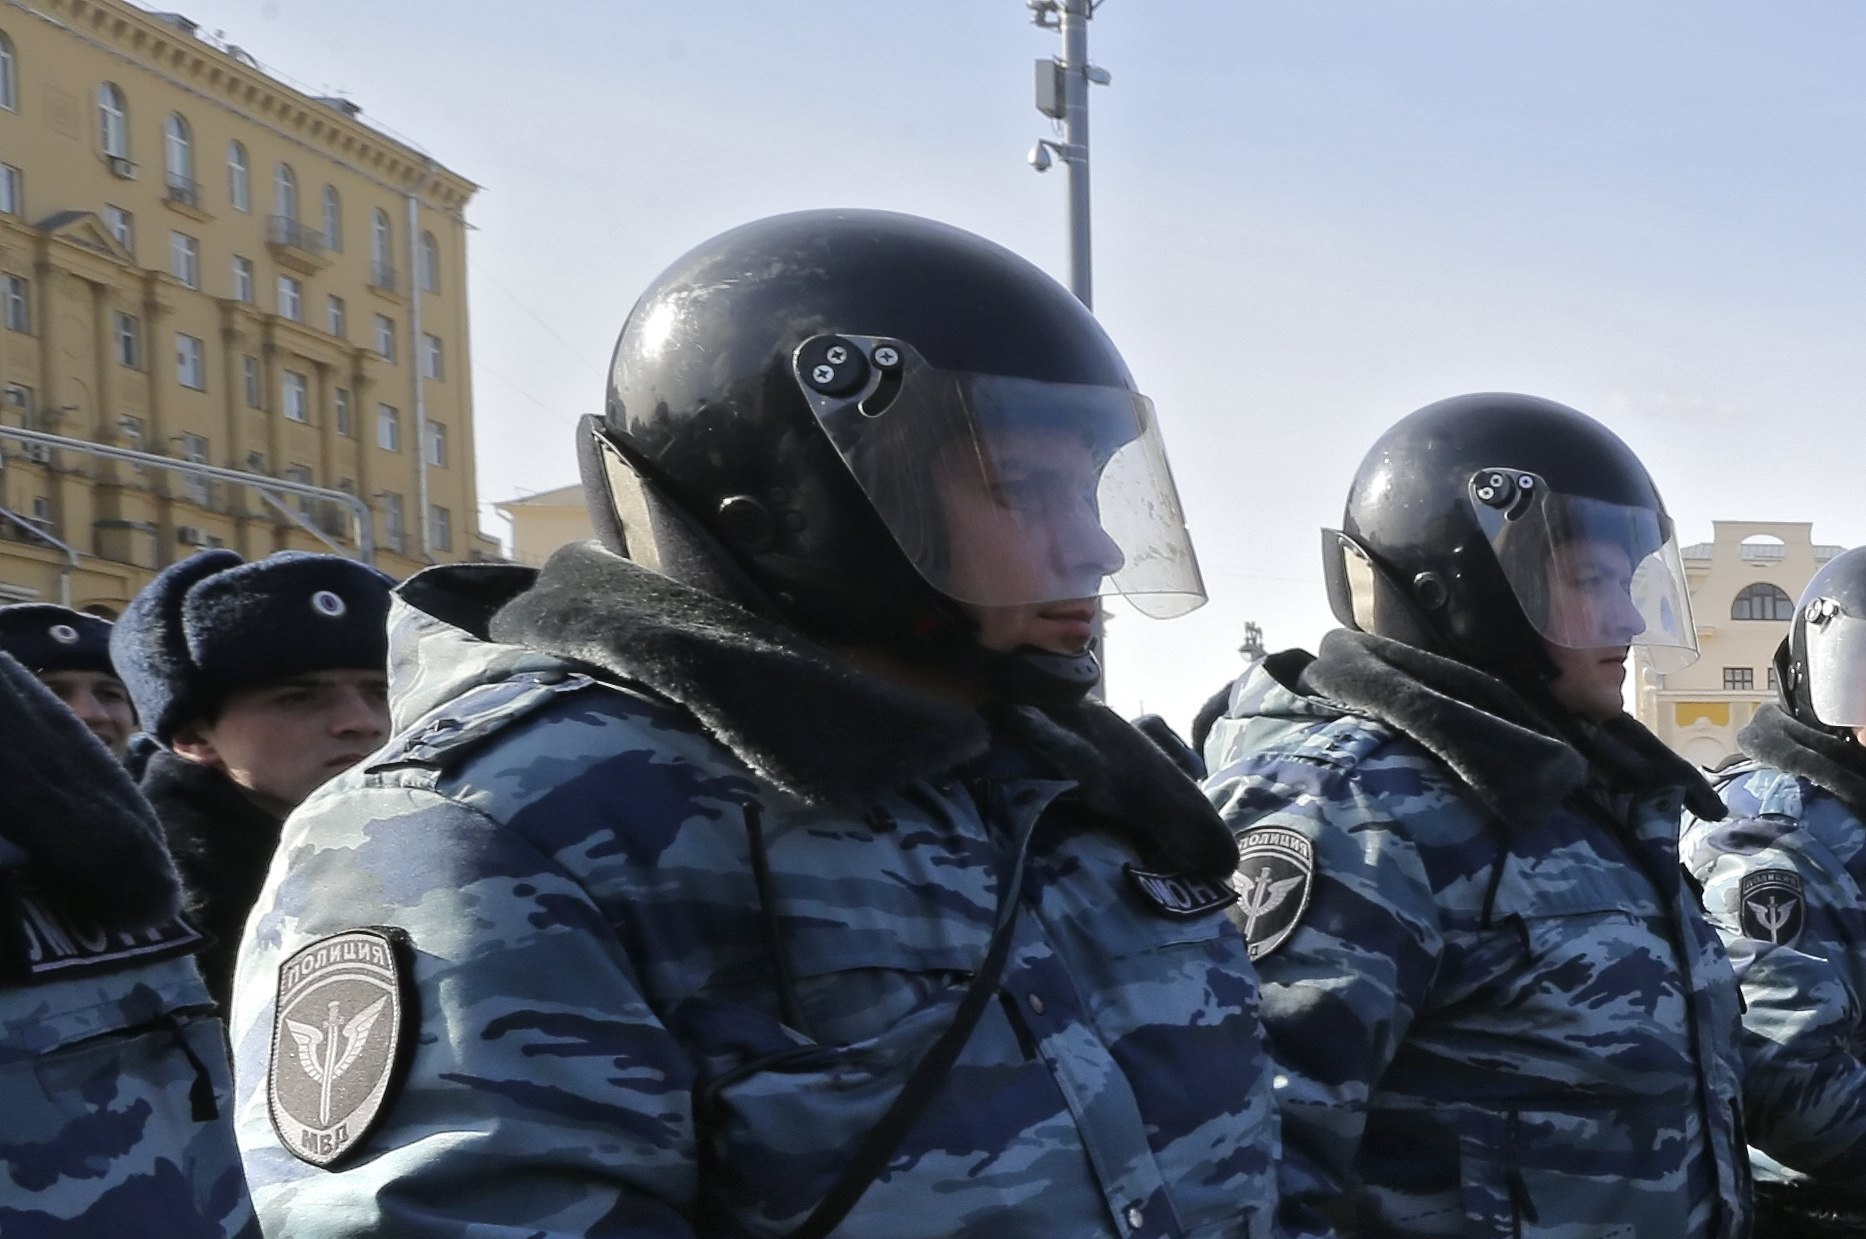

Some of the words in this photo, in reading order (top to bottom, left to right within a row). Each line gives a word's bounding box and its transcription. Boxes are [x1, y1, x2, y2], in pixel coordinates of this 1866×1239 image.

[1239, 833, 1308, 857] ПОЛИЦИЯ
[286, 942, 384, 989] ПОЛИЦИЯ
[302, 1122, 349, 1155] МВД
